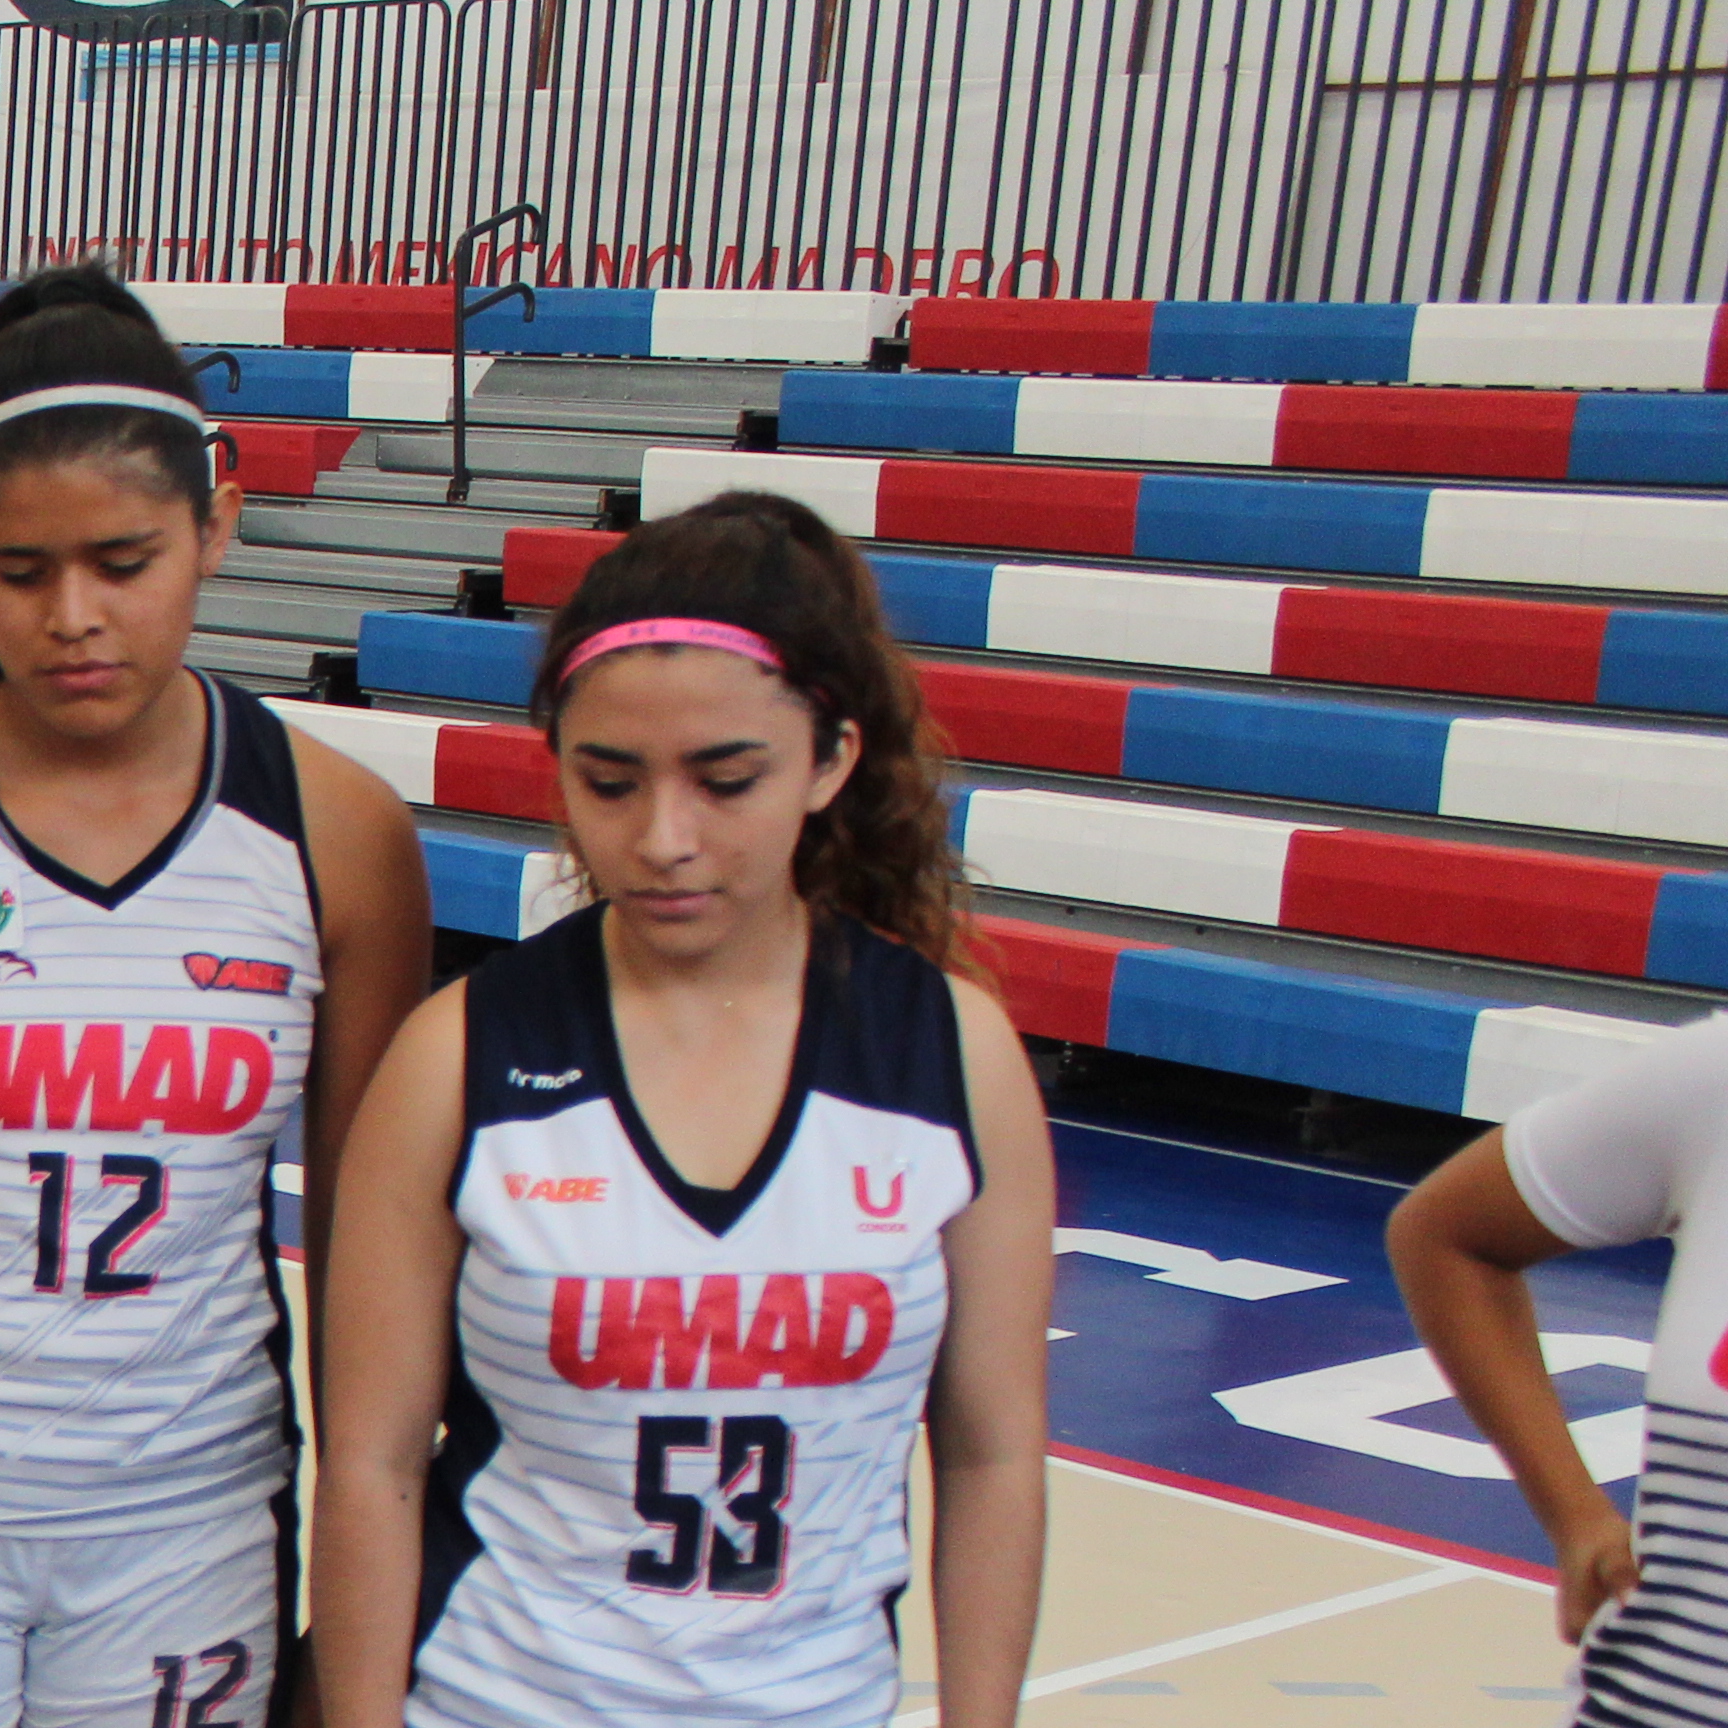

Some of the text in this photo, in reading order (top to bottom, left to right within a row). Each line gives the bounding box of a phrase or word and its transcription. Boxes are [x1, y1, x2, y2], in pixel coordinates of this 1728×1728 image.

[717, 246, 1060, 299] MADERO
[28, 1151, 170, 1300] 12
[528, 1176, 610, 1203] ABE
[548, 1271, 896, 1391] UMAD
[625, 1414, 797, 1600] 53
